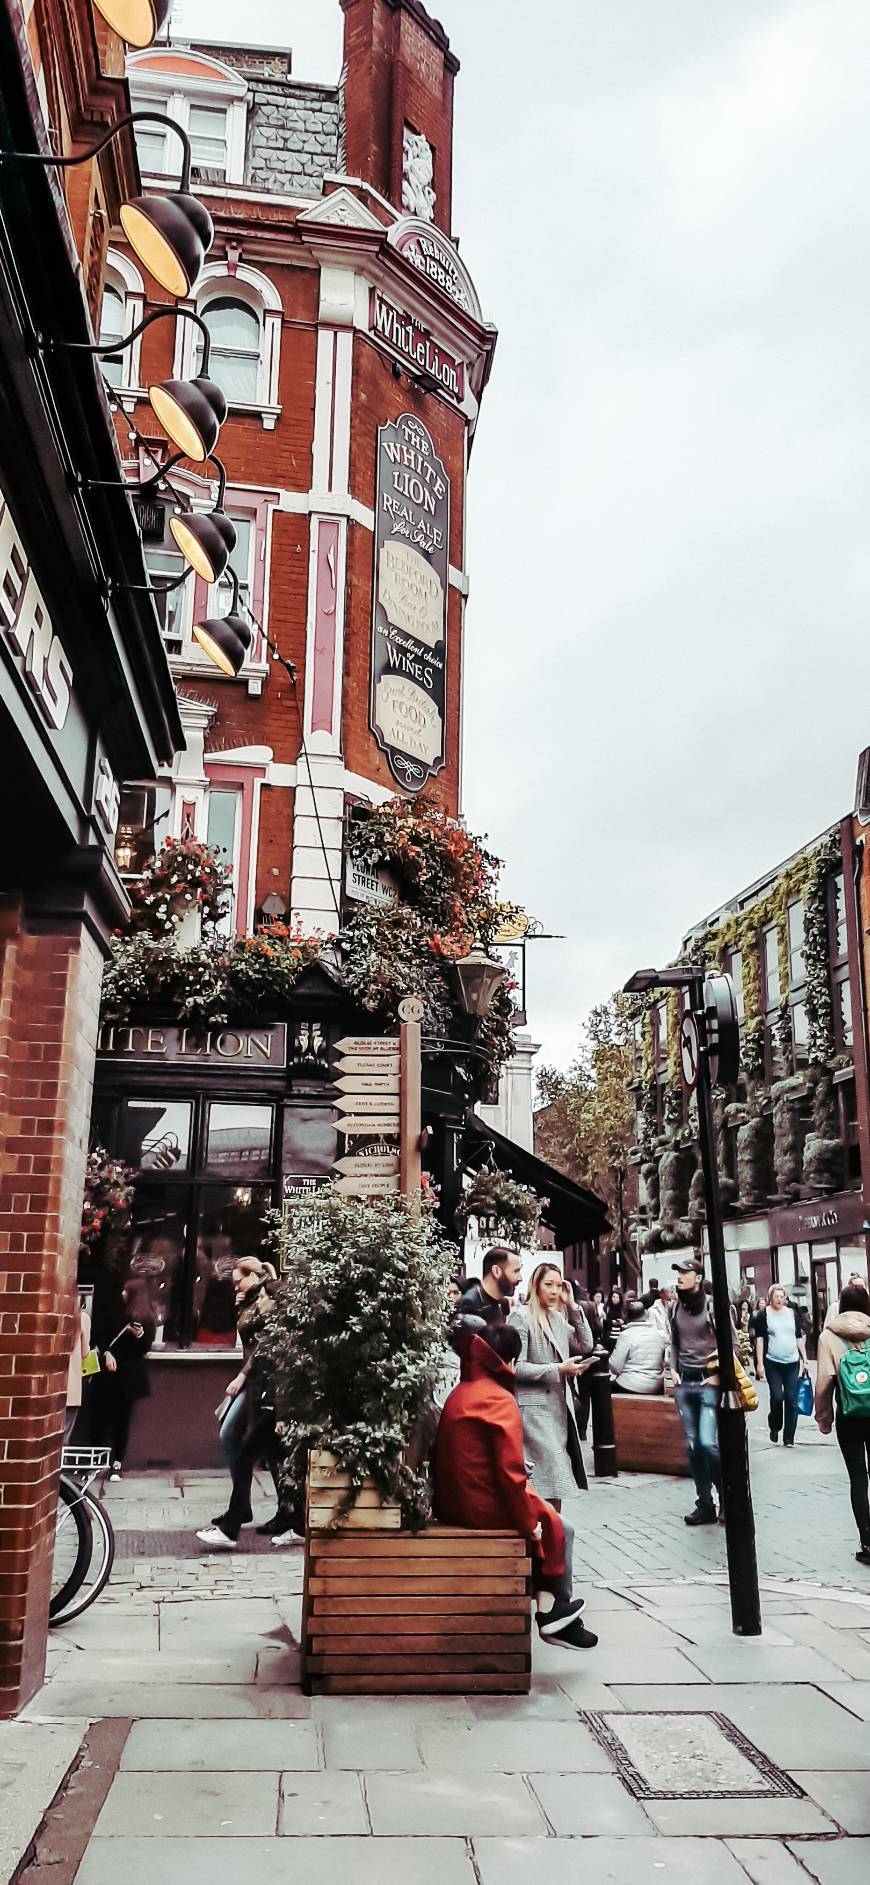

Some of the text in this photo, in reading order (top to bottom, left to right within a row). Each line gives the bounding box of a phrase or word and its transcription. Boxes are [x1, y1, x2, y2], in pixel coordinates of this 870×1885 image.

[425, 256, 454, 294] 1888
[401, 424, 430, 457] THE
[381, 441, 446, 501] WHITE
[392, 471, 437, 516] LION
[382, 492, 443, 550] REAL ALE
[390, 522, 435, 555] for Sale
[386, 550, 439, 599] BEDFORD
[0, 490, 73, 730] ERS
[389, 625, 425, 657] Excellent
[387, 641, 433, 689] WINES
[391, 699, 427, 728] FOOD
[352, 872, 379, 893] STREET
[176, 1027, 274, 1060] LION
[284, 1185, 311, 1194] WHITE
[302, 1178, 317, 1186] THE
